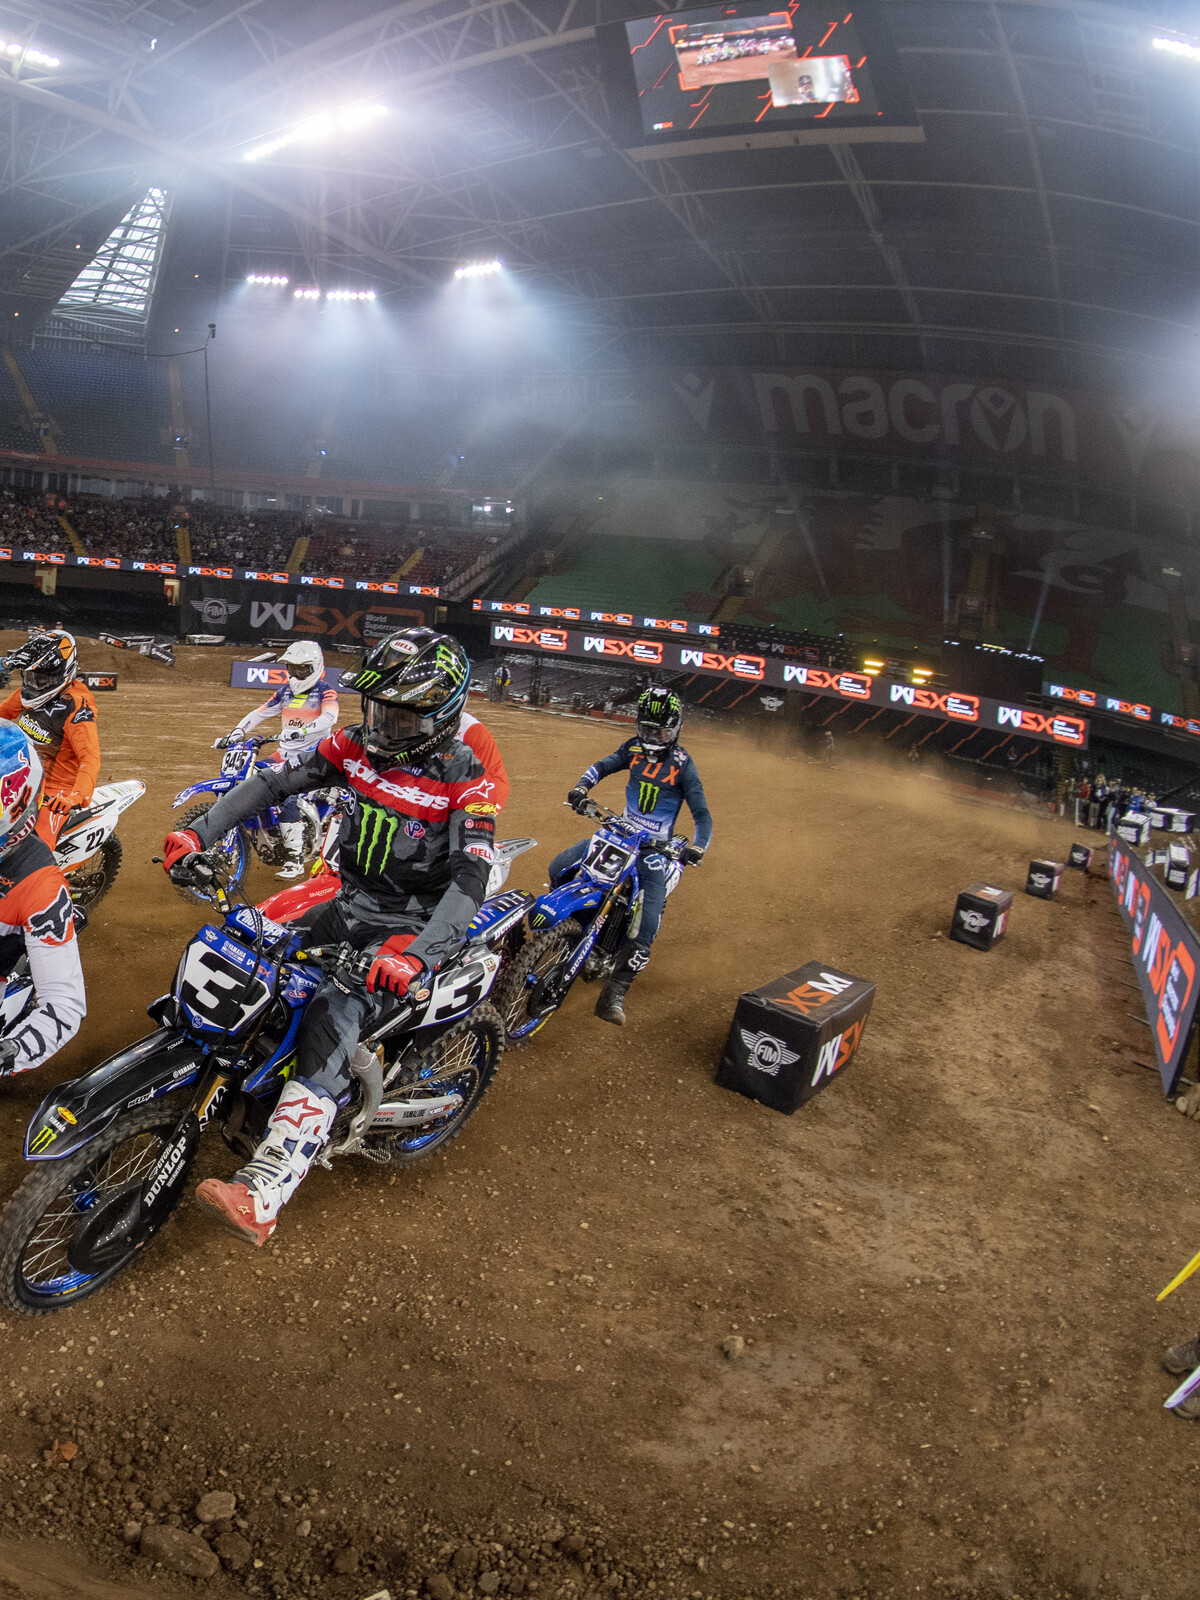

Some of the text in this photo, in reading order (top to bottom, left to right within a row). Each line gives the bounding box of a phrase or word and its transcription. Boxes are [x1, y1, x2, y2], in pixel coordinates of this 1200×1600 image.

[752, 372, 1078, 462] macron
[207, 605, 222, 616] FIM
[250, 601, 365, 638] WSX
[365, 614, 388, 622] World
[494, 626, 541, 644] WSX
[394, 641, 412, 652] BELL
[584, 636, 634, 657] WSX
[681, 650, 735, 672] WSX
[88, 676, 114, 686] WSX
[784, 665, 841, 690] WSX
[890, 684, 948, 711] WSX
[21, 715, 50, 736] MOUNTAIN
[288, 720, 304, 728] Dafy
[998, 706, 1054, 734] WSX
[223, 752, 248, 772] 945
[630, 754, 680, 786] FOX
[344, 758, 450, 809] alpinestars
[85, 828, 104, 853] 22
[470, 847, 492, 860] BELL
[228, 942, 246, 958] YAMAHA
[569, 936, 595, 976] DUNLOP
[180, 952, 268, 1027] 3
[434, 962, 485, 1020] 3
[168, 1038, 184, 1050] TOMAC
[756, 1045, 777, 1062] FIM
[811, 1014, 867, 1086] WSX
[178, 1062, 196, 1076] YAMAHA
[402, 1108, 426, 1119] YAMALUBE
[144, 1136, 187, 1208] DUNLOP
